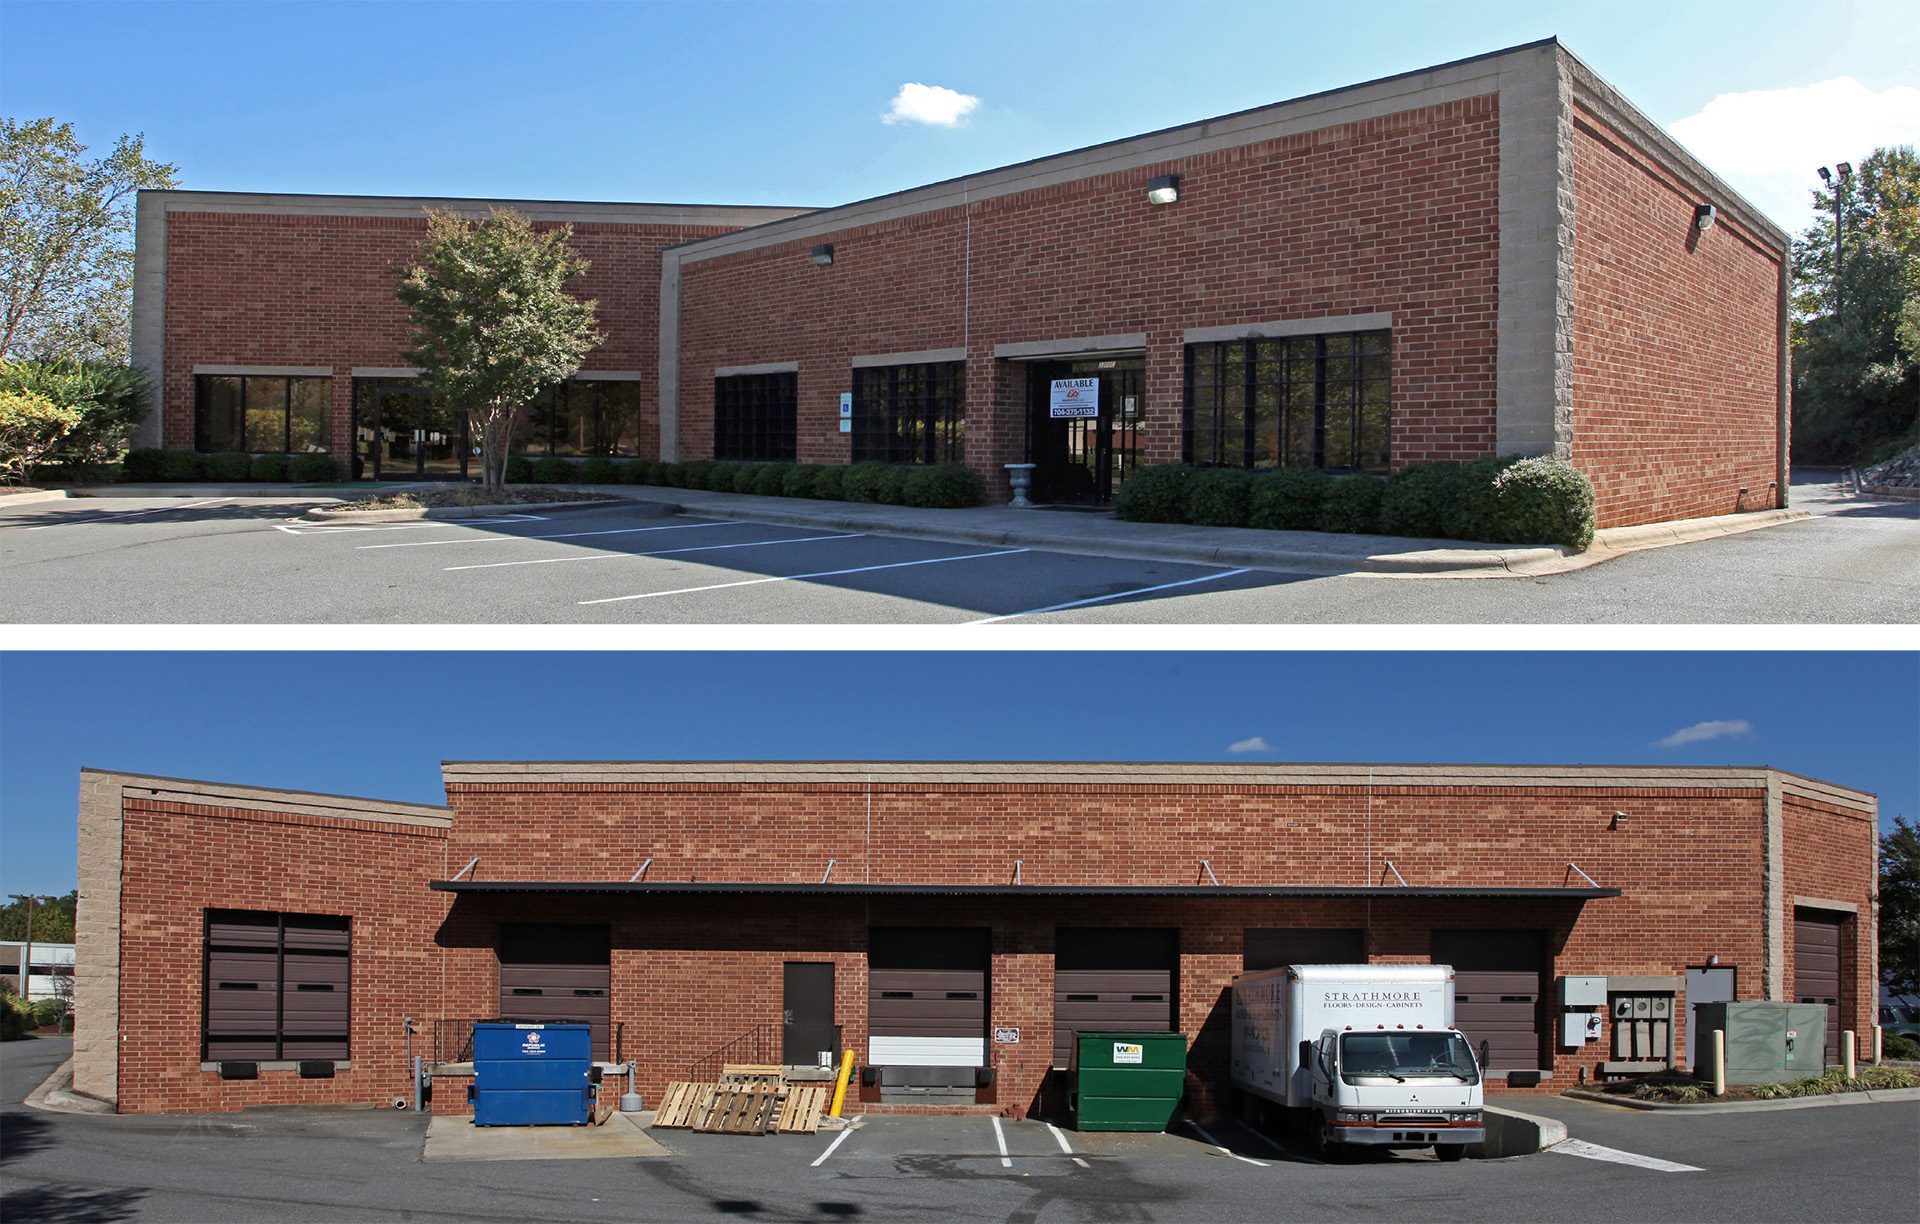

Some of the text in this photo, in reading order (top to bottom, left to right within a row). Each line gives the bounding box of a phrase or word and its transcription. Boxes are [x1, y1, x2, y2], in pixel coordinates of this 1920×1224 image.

[1055, 379, 1094, 388] AVAILABLE
[1053, 408, 1095, 416] 704-375-1132
[1324, 992, 1421, 1001] STRATHMORE
